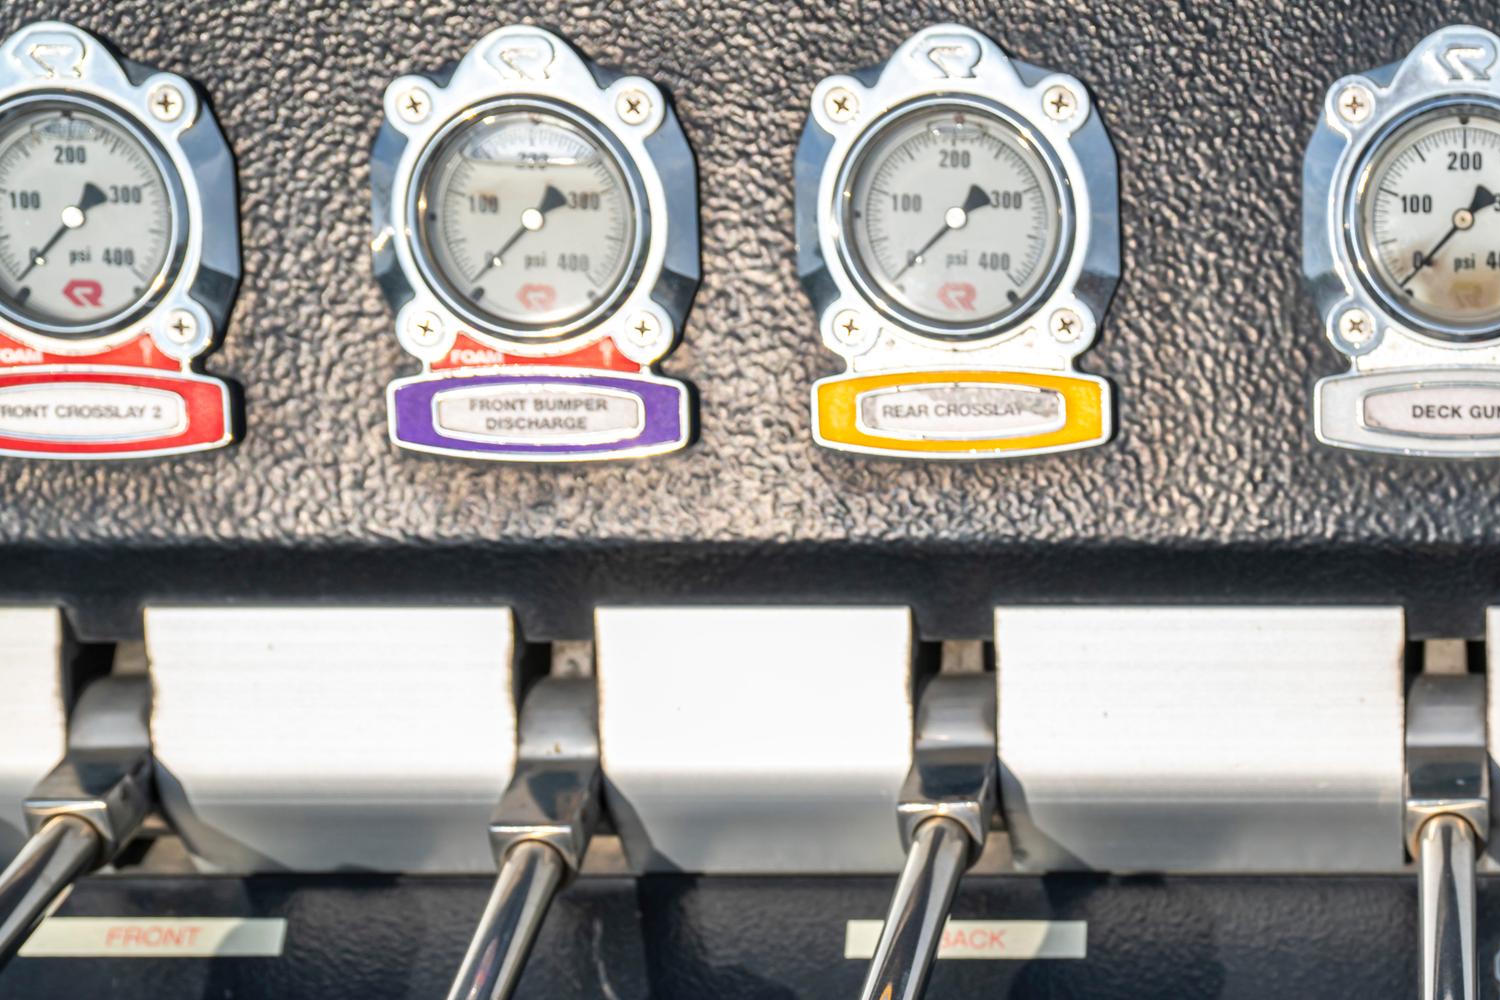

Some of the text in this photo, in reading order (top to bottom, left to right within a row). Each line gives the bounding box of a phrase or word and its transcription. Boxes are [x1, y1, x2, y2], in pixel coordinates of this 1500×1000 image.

[54, 145, 86, 164] 200
[939, 150, 970, 168] 200
[1447, 152, 1482, 171] 200
[10, 191, 40, 209] 100
[109, 186, 141, 204] 300
[468, 194, 498, 213] 100
[568, 191, 599, 209] 300
[892, 194, 922, 212] 100
[990, 191, 1022, 209] 300
[1401, 194, 1432, 213] 100
[70, 247, 91, 265] psi
[102, 248, 134, 266] 400
[524, 251, 547, 270] psi
[557, 254, 589, 271] 400
[945, 251, 967, 269] psi
[978, 253, 1010, 271] 400
[1453, 252, 1475, 271] psi
[0, 348, 43, 363] OAM
[450, 349, 503, 365] FOAM
[0, 404, 162, 419] RONT CROSSLAY 2
[470, 398, 608, 412] FRONT BUMPER
[882, 402, 1023, 419] REAR CROSSLAY
[1412, 405, 1462, 419] DECK
[486, 417, 587, 431] DISCHARGE
[105, 926, 203, 948] FRONT
